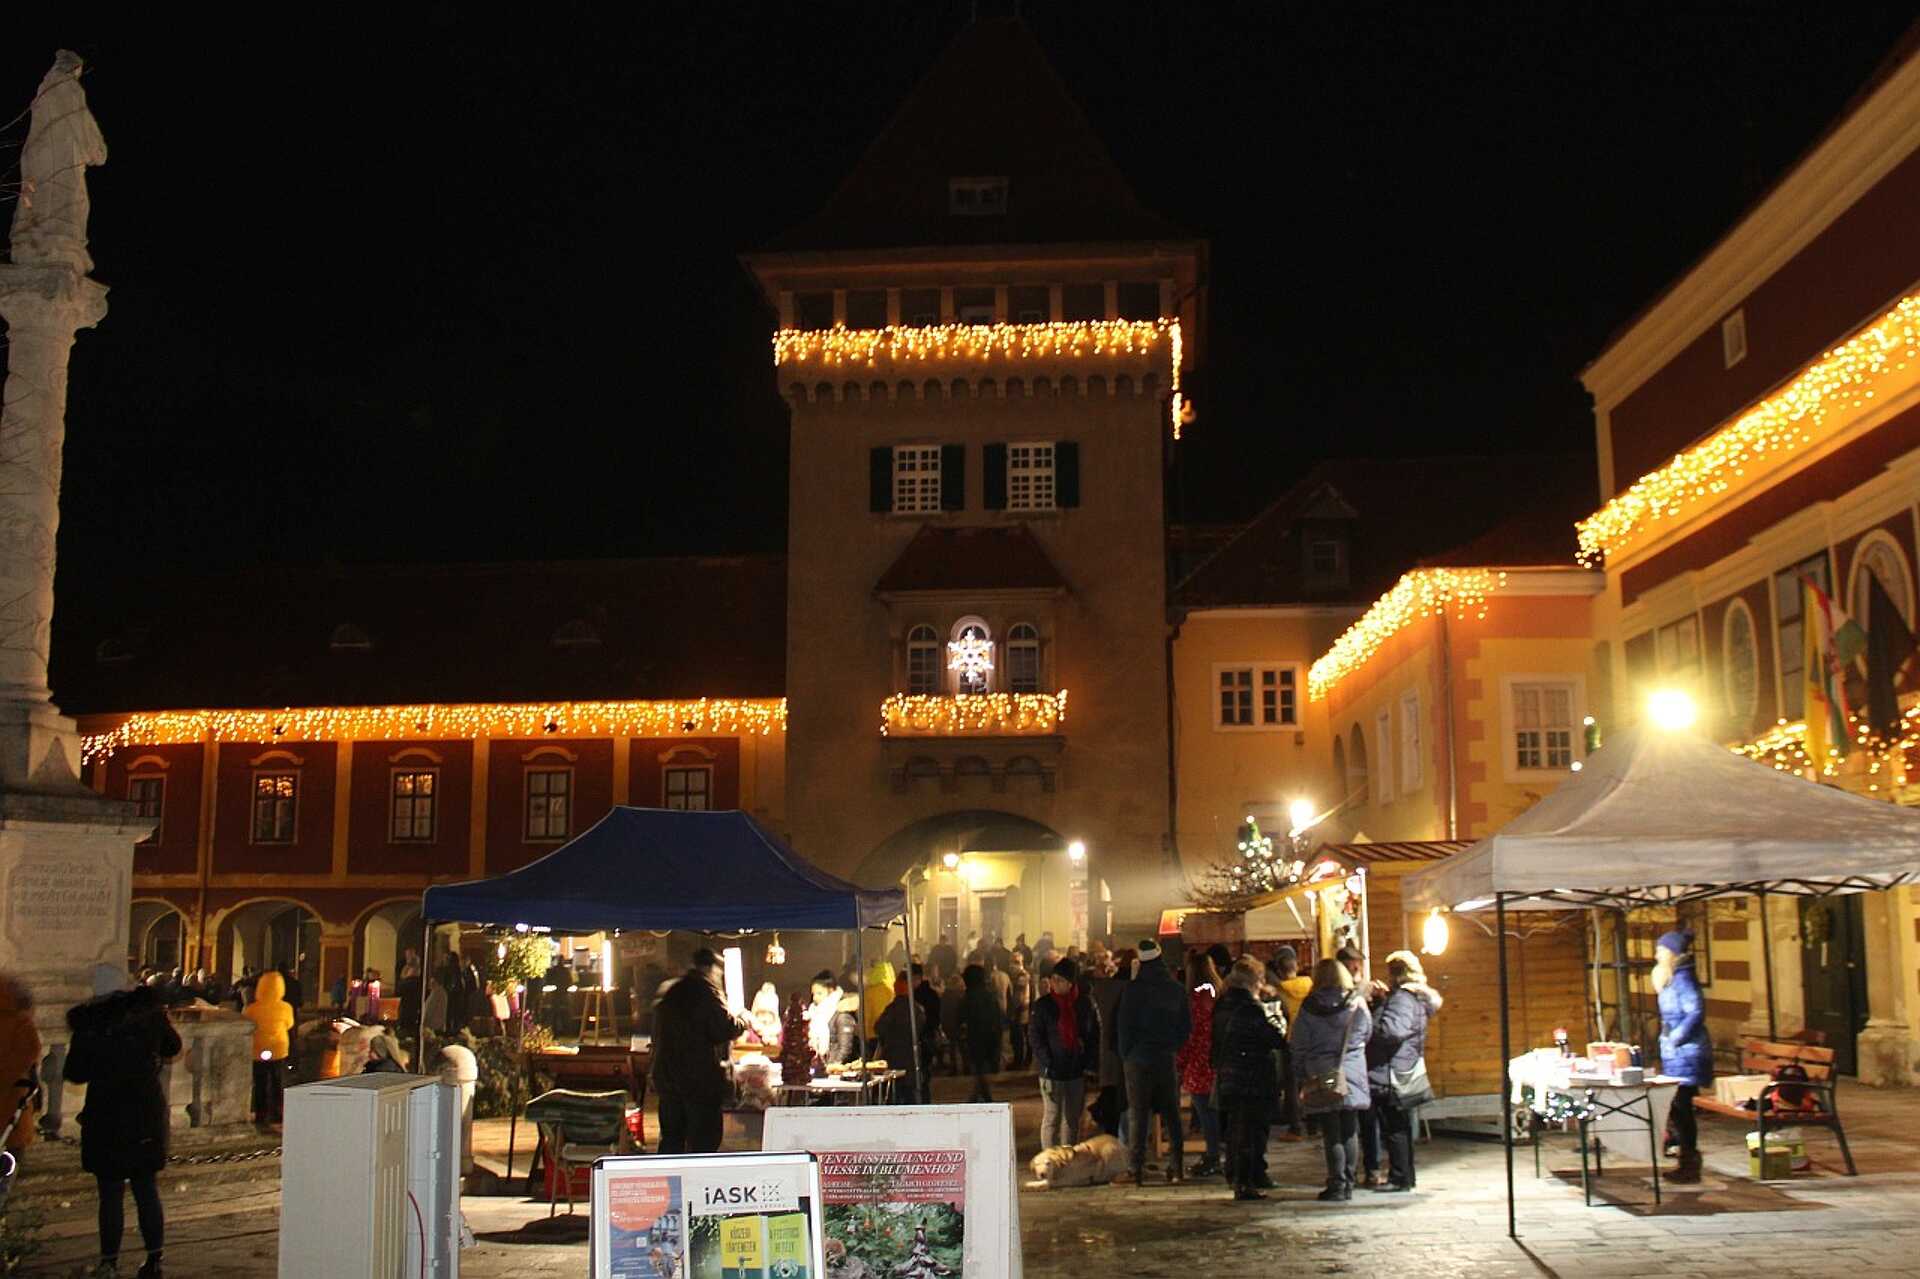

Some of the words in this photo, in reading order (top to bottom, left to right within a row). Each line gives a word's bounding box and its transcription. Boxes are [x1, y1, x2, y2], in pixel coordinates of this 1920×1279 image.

[935, 1152, 964, 1163] UND
[879, 1163, 960, 1175] BLUMENHOF
[704, 1186, 757, 1205] iASK
